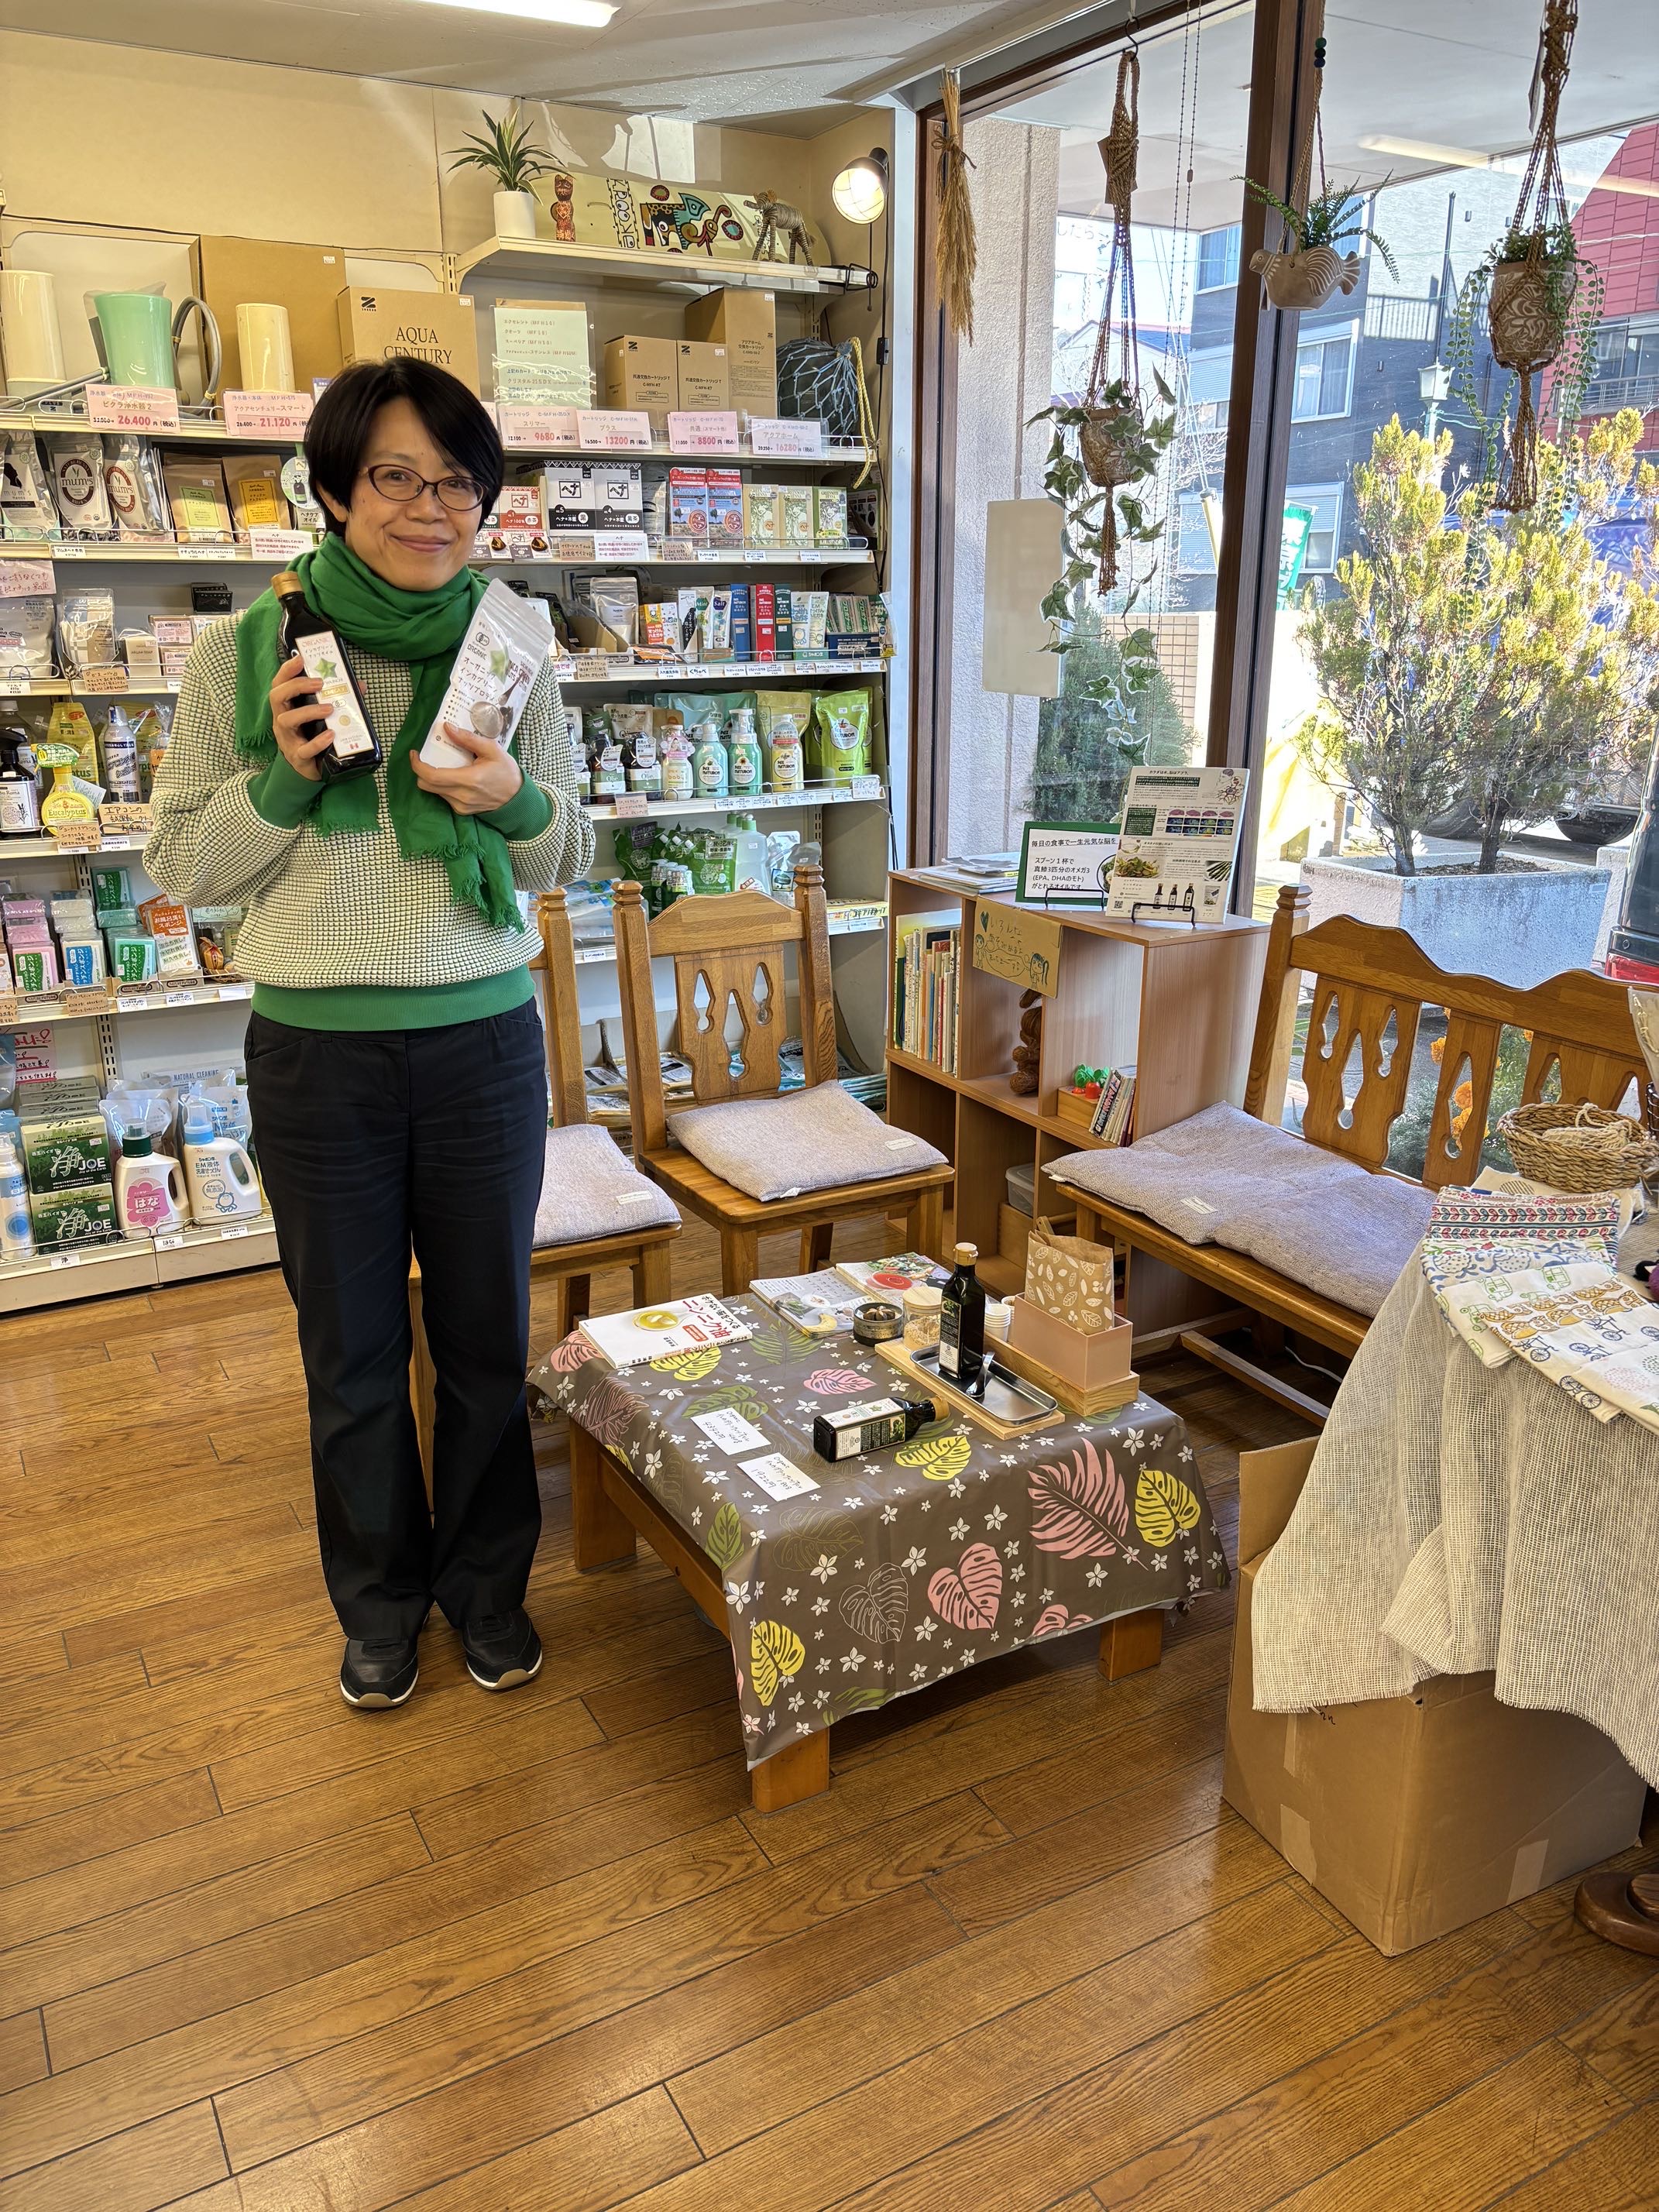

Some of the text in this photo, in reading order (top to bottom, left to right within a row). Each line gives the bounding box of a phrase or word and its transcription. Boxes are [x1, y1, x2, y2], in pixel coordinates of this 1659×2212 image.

[396, 327, 439, 343] AQUA
[384, 346, 452, 364] CENTURY
[118, 415, 150, 426] 26.400
[260, 418, 290, 427] 21.120
[534, 432, 555, 441] 9680
[605, 437, 628, 445] 13200
[698, 437, 716, 445] 8800
[776, 444, 797, 452] 16280
[61, 477, 94, 486] mum's
[562, 483, 579, 496] ヘナ
[610, 484, 627, 496] ヘナ
[513, 496, 527, 507] ヘナ
[467, 644, 488, 661] ORGANIC
[464, 657, 496, 680] オーガニック
[461, 668, 498, 692] インカグリーン
[47, 809, 87, 819] Eucalyptus
[1032, 838, 1116, 847] 毎日の食事で一生元気な脳を
[154, 914, 185, 924] お風呂洗い
[174, 1073, 194, 1082] NATURAL
[78, 1156, 106, 1170] JOE
[135, 1197, 159, 1208] はな
[84, 1218, 112, 1232] JOE
[682, 1300, 732, 1338] ニンニク油
